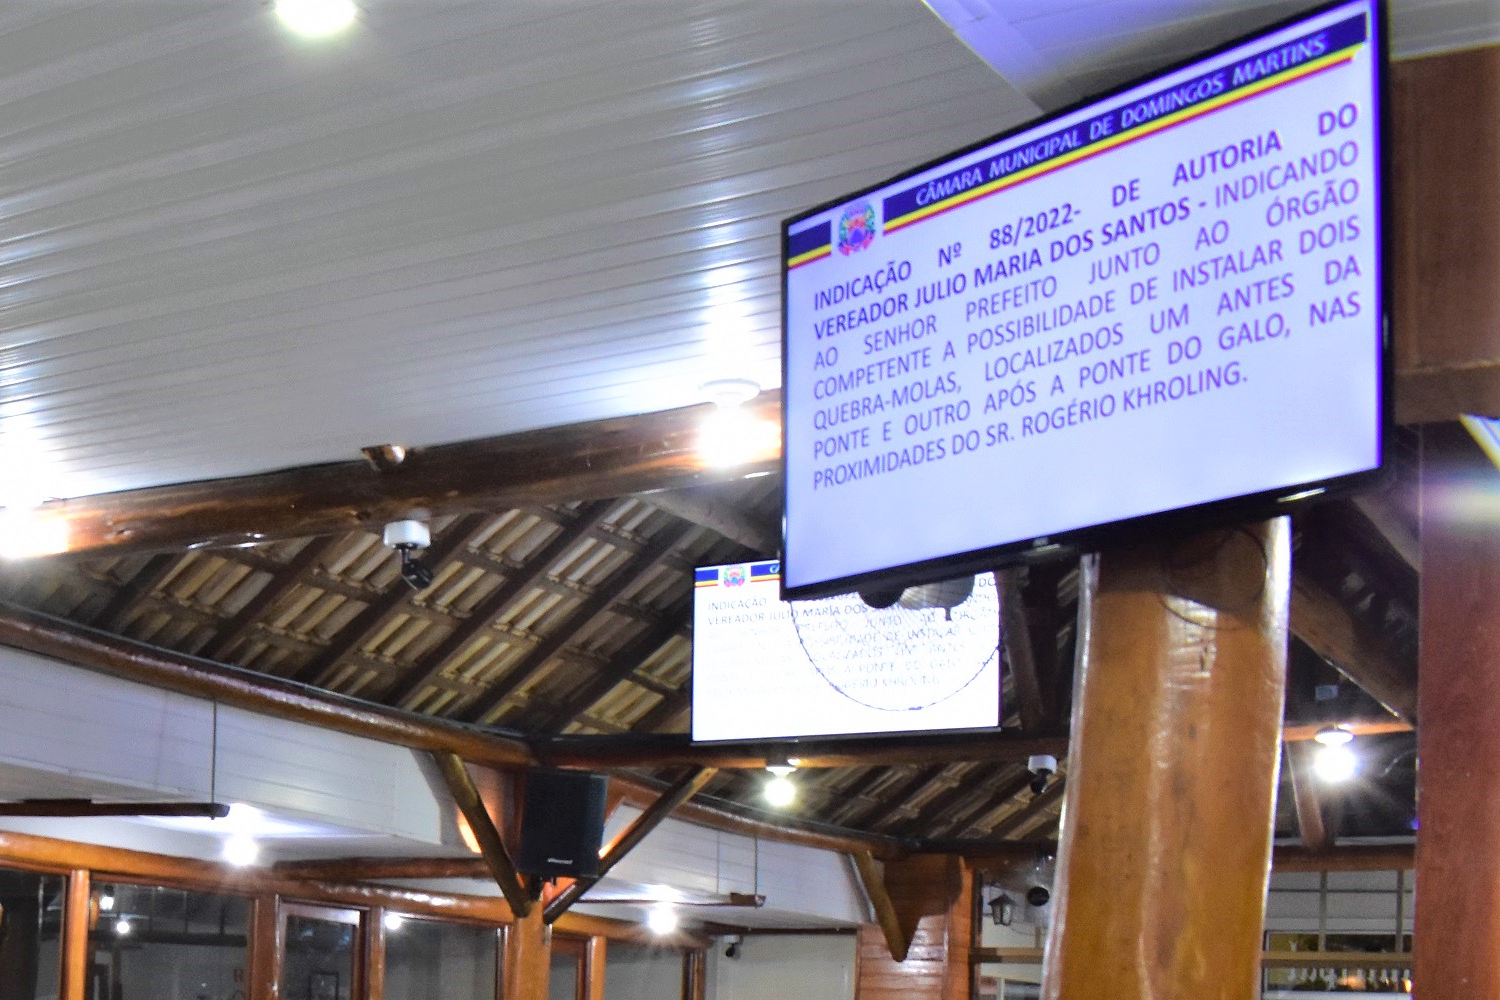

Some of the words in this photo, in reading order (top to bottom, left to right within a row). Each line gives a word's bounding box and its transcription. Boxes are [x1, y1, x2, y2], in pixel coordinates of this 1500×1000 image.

[814, 259, 912, 311] INDICAÇÃO
[937, 241, 963, 269] Nº
[988, 202, 1082, 251] 88/2022-
[1111, 177, 1141, 209] DE
[1172, 129, 1283, 188] AUTORIA
[1317, 101, 1359, 137] DO
[915, 168, 983, 206] CÂMARA
[989, 130, 1082, 178] MUNICIPAL
[1090, 114, 1114, 140] DE
[1121, 71, 1226, 128] DOMINGOS
[1233, 31, 1327, 86] MARTINS
[813, 292, 909, 341] VEREADOR
[913, 272, 968, 309] JULIO
[973, 247, 1043, 289] MARIA
[1049, 228, 1094, 264] DOS
[1101, 195, 1191, 247] SANTOS
[1215, 139, 1359, 209] INDICANDO
[813, 346, 932, 400] COMPETENTE
[943, 340, 956, 362] A
[967, 289, 1115, 354] POSSIBILIDADE
[1130, 276, 1158, 306] DE
[1173, 238, 1284, 293] INSTALAR
[1299, 215, 1361, 256] DOIS
[814, 346, 839, 370] AO
[863, 314, 938, 356] SENHOR
[965, 275, 1057, 322] PREFEITO
[1088, 241, 1161, 285] JUNTO
[1195, 219, 1230, 251] AO
[1265, 177, 1360, 228] ÓRGÃO
[813, 371, 962, 431] QUEBRA-MOLAS,
[985, 321, 1124, 382] LOCALIZADOS
[1149, 302, 1189, 335] UM
[1216, 271, 1295, 317] ANTES
[1324, 254, 1362, 286] DA
[813, 437, 946, 490] PROXIMIDADES
[951, 429, 981, 456] DO
[985, 421, 1014, 447] SR.
[1022, 393, 1116, 437] ROGÉRIO
[1123, 360, 1248, 412] KHROLING.
[814, 426, 869, 460] PONTE
[882, 421, 891, 442] E
[904, 399, 971, 436] OUTRO
[983, 380, 1037, 415] APÓS
[1050, 374, 1065, 397] A
[1079, 348, 1151, 389] PONTE
[1167, 335, 1203, 366] DO
[1218, 312, 1291, 351] GALO,
[1309, 290, 1362, 327] NAS
[708, 596, 767, 611] INDICAÇÃO
[708, 612, 765, 625] VEREADOR
